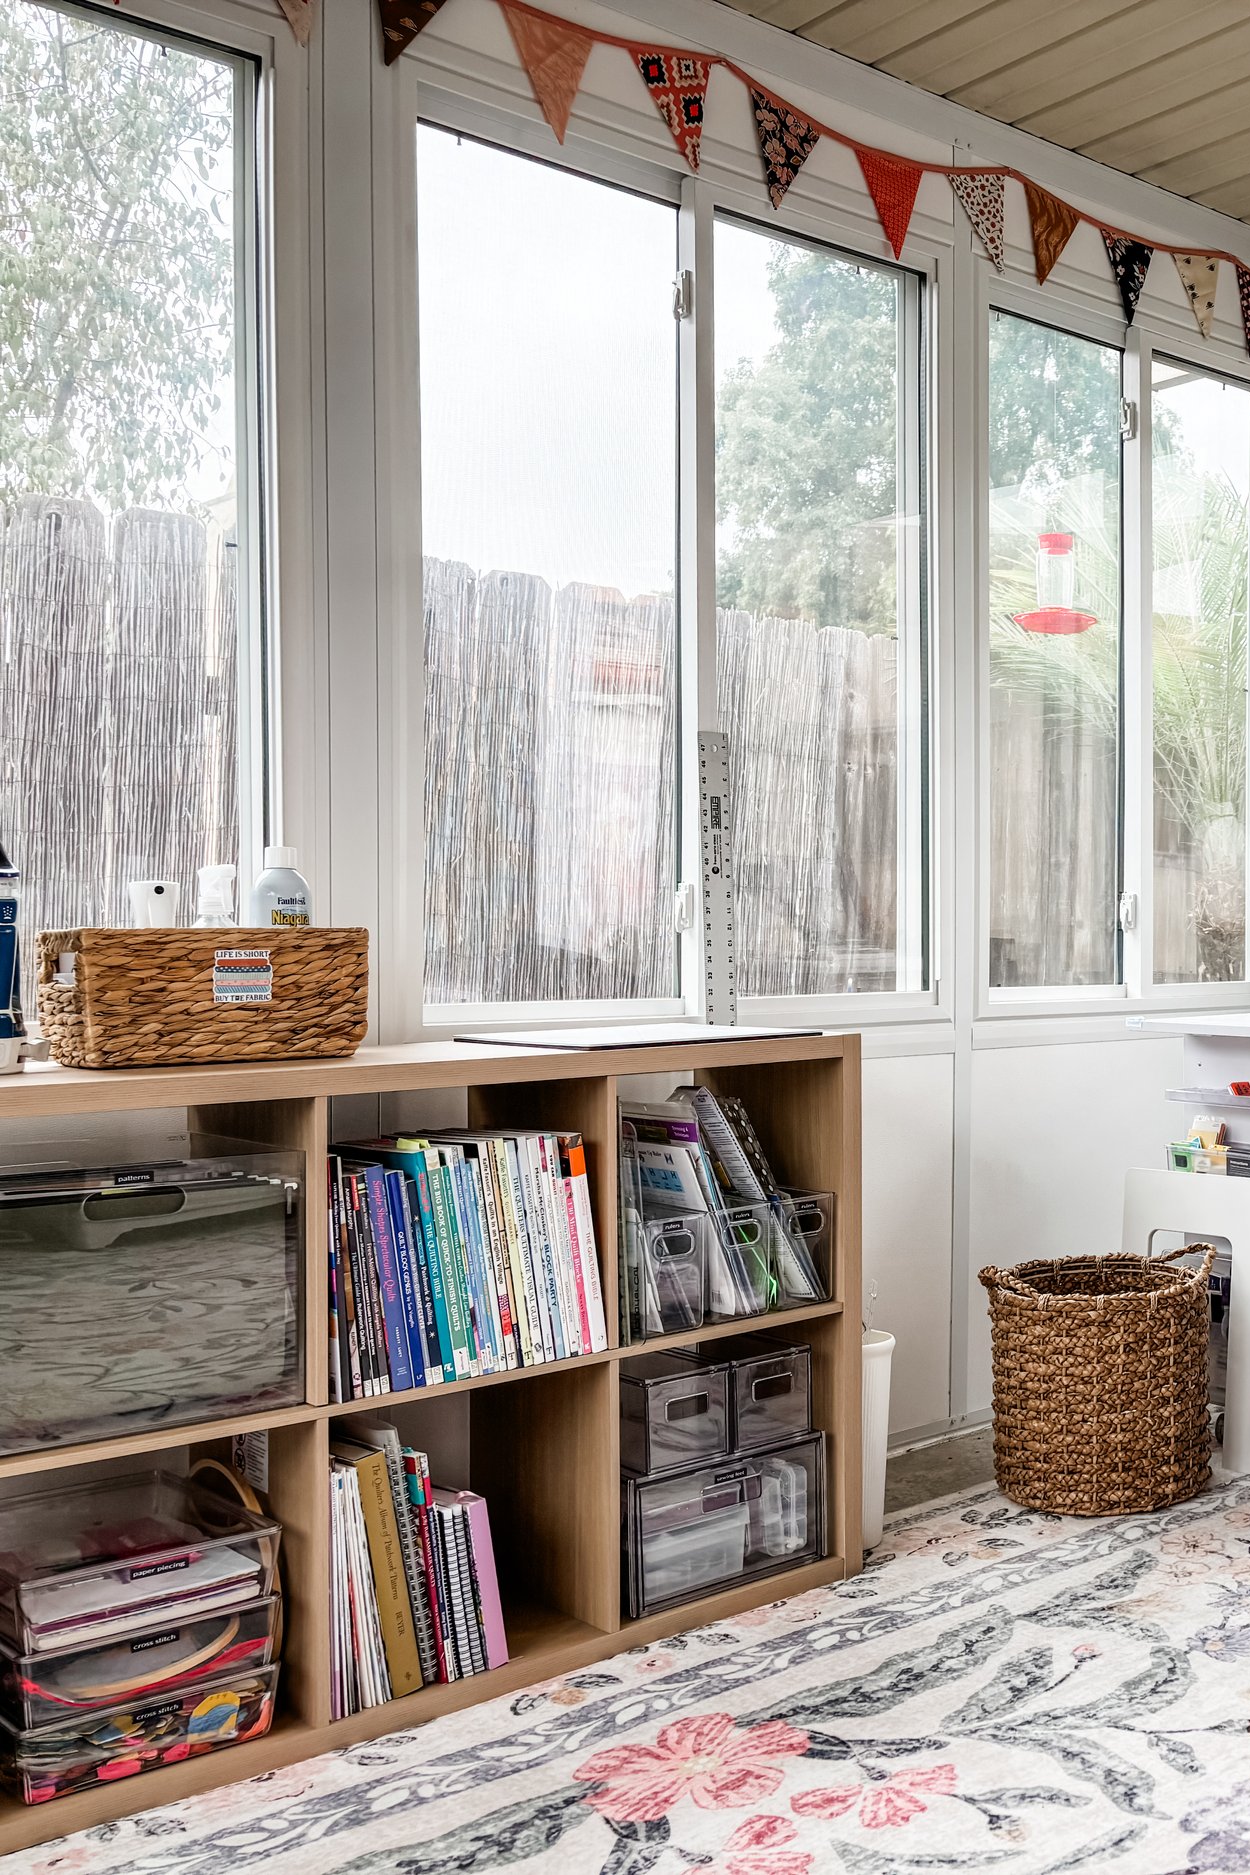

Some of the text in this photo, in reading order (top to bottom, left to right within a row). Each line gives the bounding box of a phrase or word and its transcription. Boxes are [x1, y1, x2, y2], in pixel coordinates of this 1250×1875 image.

[710, 796, 720, 829] EMPIRE
[271, 910, 310, 927] Niagara
[483, 1172, 492, 1196] Fassett's
[501, 1174, 509, 1197] Fassett's
[534, 1167, 542, 1194] Marsha
[436, 1205, 445, 1226] BOOK
[487, 1201, 495, 1219] Quilts
[536, 1196, 548, 1241] McCloskey's
[369, 1180, 396, 1302] Simple Shapes Spectacular Quilts
[440, 1227, 447, 1237] OF
[366, 1242, 375, 1278] Free-Motion
[400, 1251, 408, 1271] BLOCK
[425, 1222, 442, 1298] THE QUILTING BIBLE
[492, 1238, 501, 1261] English
[520, 1234, 531, 1274] ULTIMATE
[543, 1243, 552, 1275] BLOCK
[440, 1239, 457, 1303] QUICK-TO-FINISH
[495, 1262, 504, 1284] Village
[586, 1246, 596, 1279] QUILTING
[369, 1279, 378, 1301] Quilting
[403, 1272, 411, 1294] GENIUS
[420, 1266, 430, 1294] Patchwork
[525, 1275, 535, 1303] VISUAL
[548, 1278, 557, 1306] PARTY
[424, 1302, 434, 1325] Quilting
[450, 1304, 461, 1330] QUILTS
[529, 1305, 538, 1329] GUIDE
[358, 1329, 366, 1350] Quilting
[371, 1464, 380, 1475] The
[378, 1506, 390, 1529] Album
[383, 1540, 397, 1571] Patchwork
[133, 1560, 186, 1578] paper piecing
[428, 1566, 436, 1586] QUILTS
[389, 1573, 401, 1599] Patterns
[394, 1611, 405, 1636] BEYER
[133, 1634, 177, 1650] cross stitch
[136, 1703, 179, 1721] cross stitch
